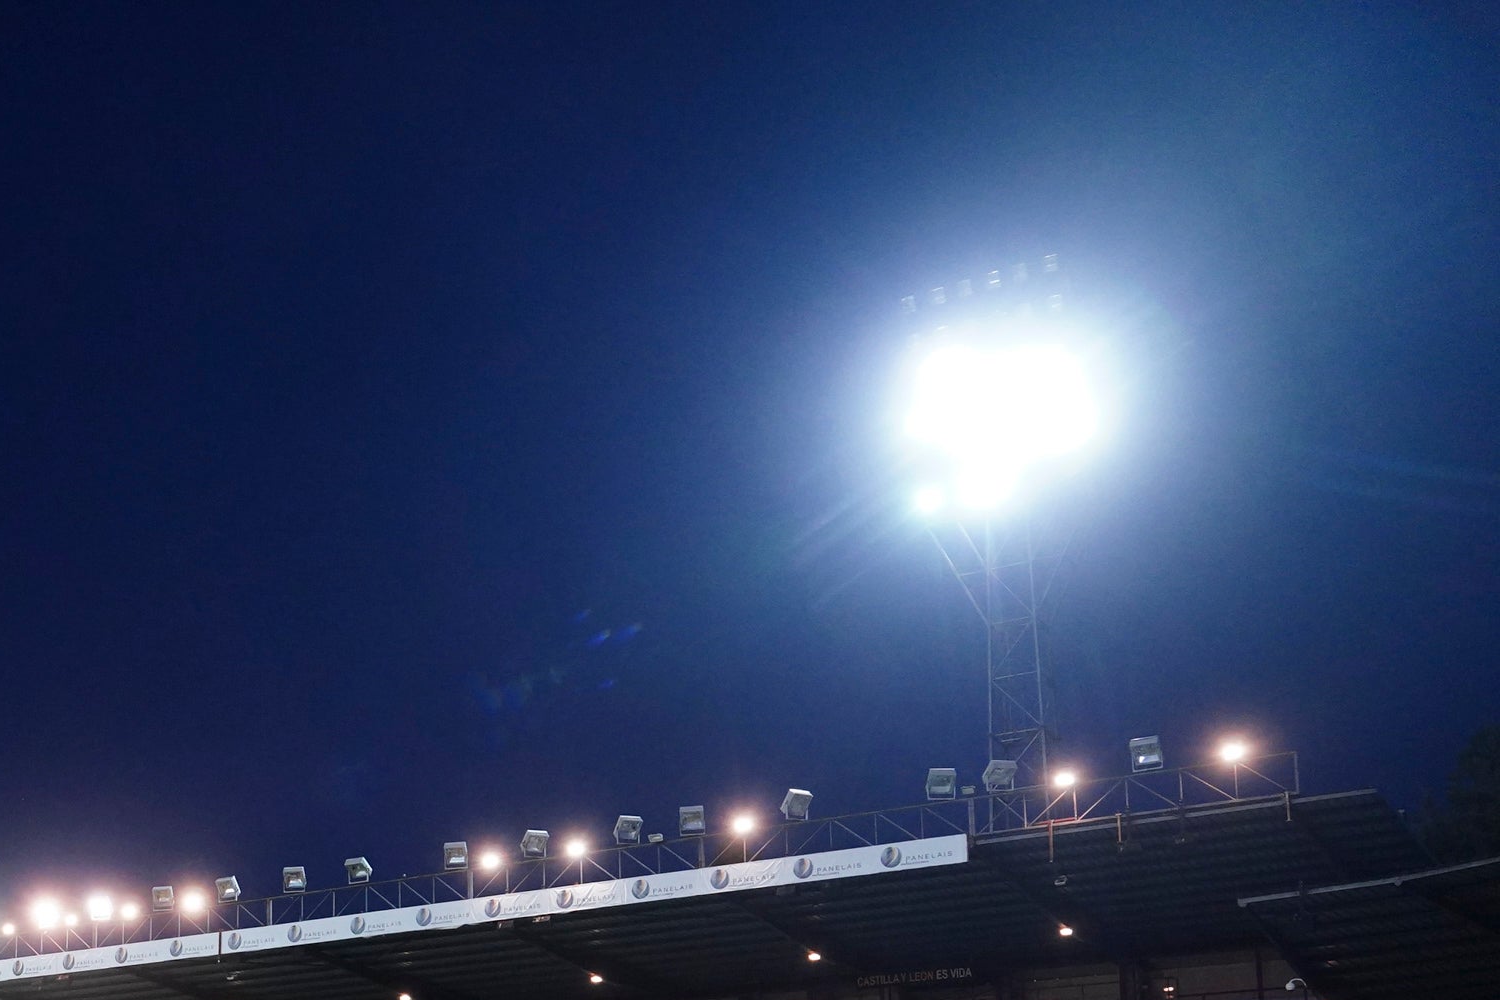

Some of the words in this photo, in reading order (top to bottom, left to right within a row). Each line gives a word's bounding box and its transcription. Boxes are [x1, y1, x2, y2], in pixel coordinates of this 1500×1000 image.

[905, 850, 953, 865] PANELAIS
[816, 862, 862, 876] PANELAIS
[652, 883, 694, 895] PANELAIS
[857, 973, 900, 987] CASTILLA
[936, 969, 948, 980] ES
[950, 967, 972, 979] VIDA
